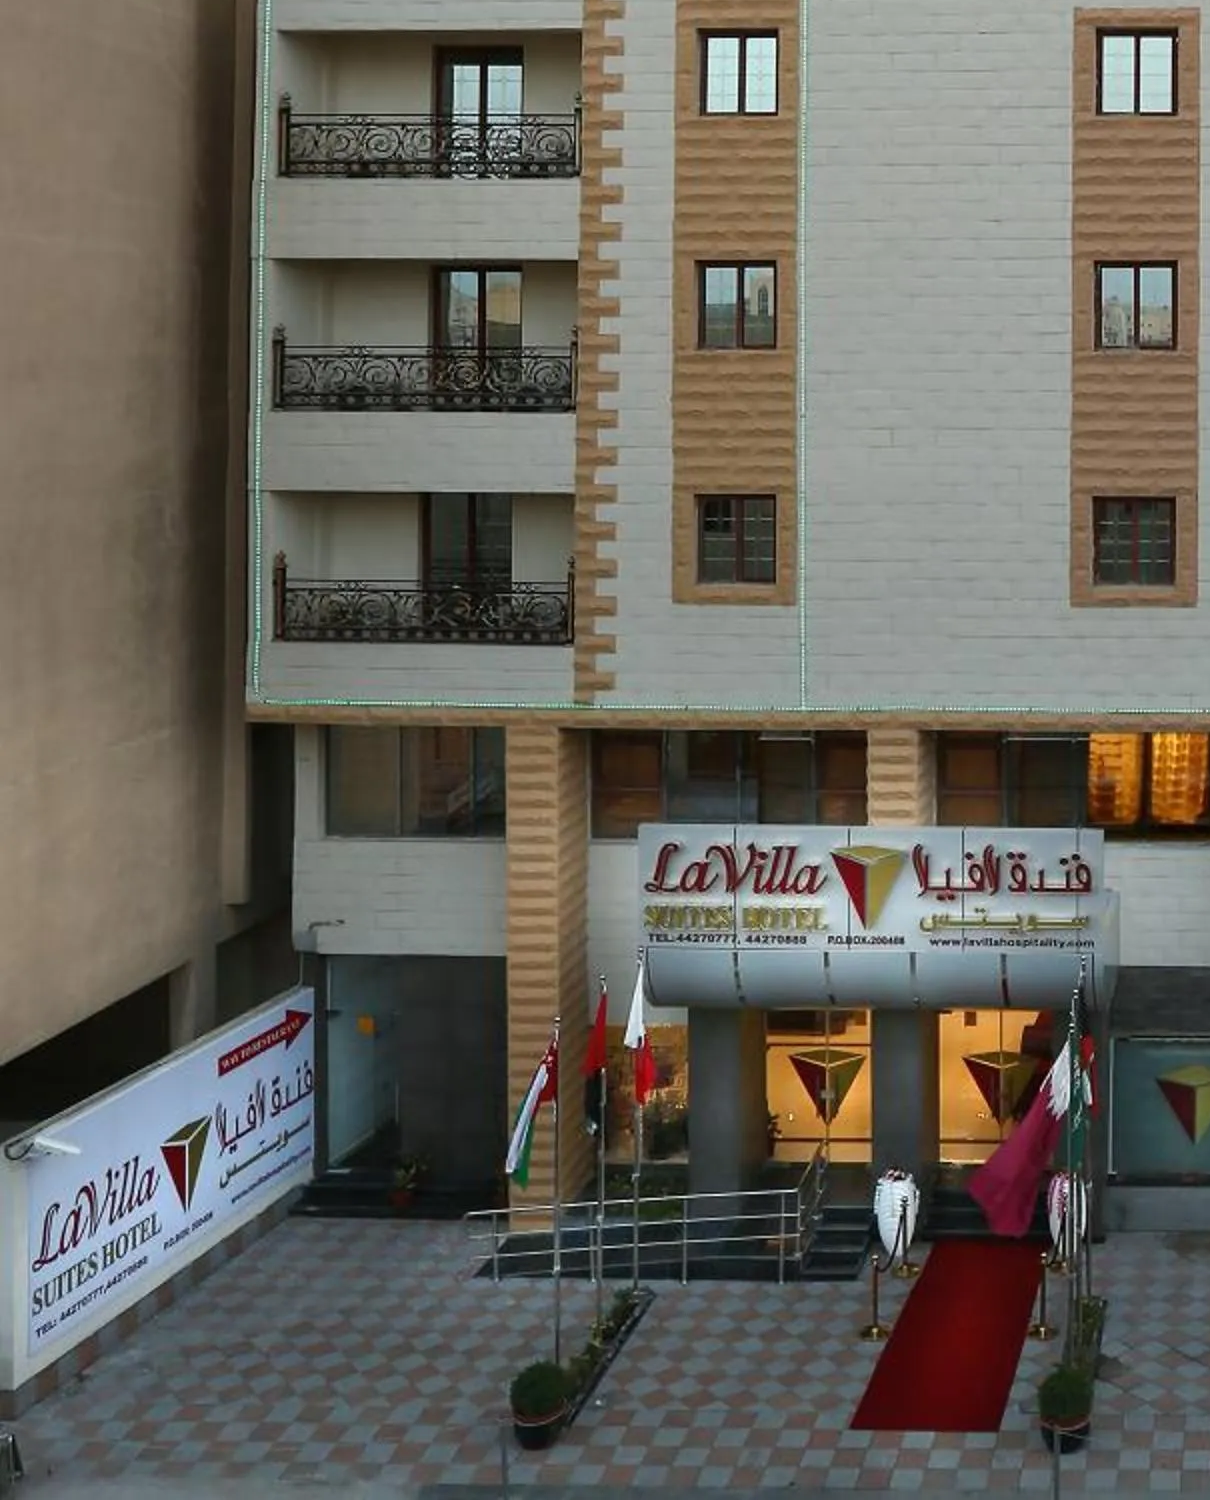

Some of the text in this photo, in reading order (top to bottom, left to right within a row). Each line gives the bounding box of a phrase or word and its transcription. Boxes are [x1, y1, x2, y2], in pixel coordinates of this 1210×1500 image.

[644, 842, 829, 895] LaVilla
[643, 905, 829, 932] SUITES HOTEL
[32, 1155, 161, 1273] LaVilla
[32, 1212, 162, 1317] SUITES HOTEL
